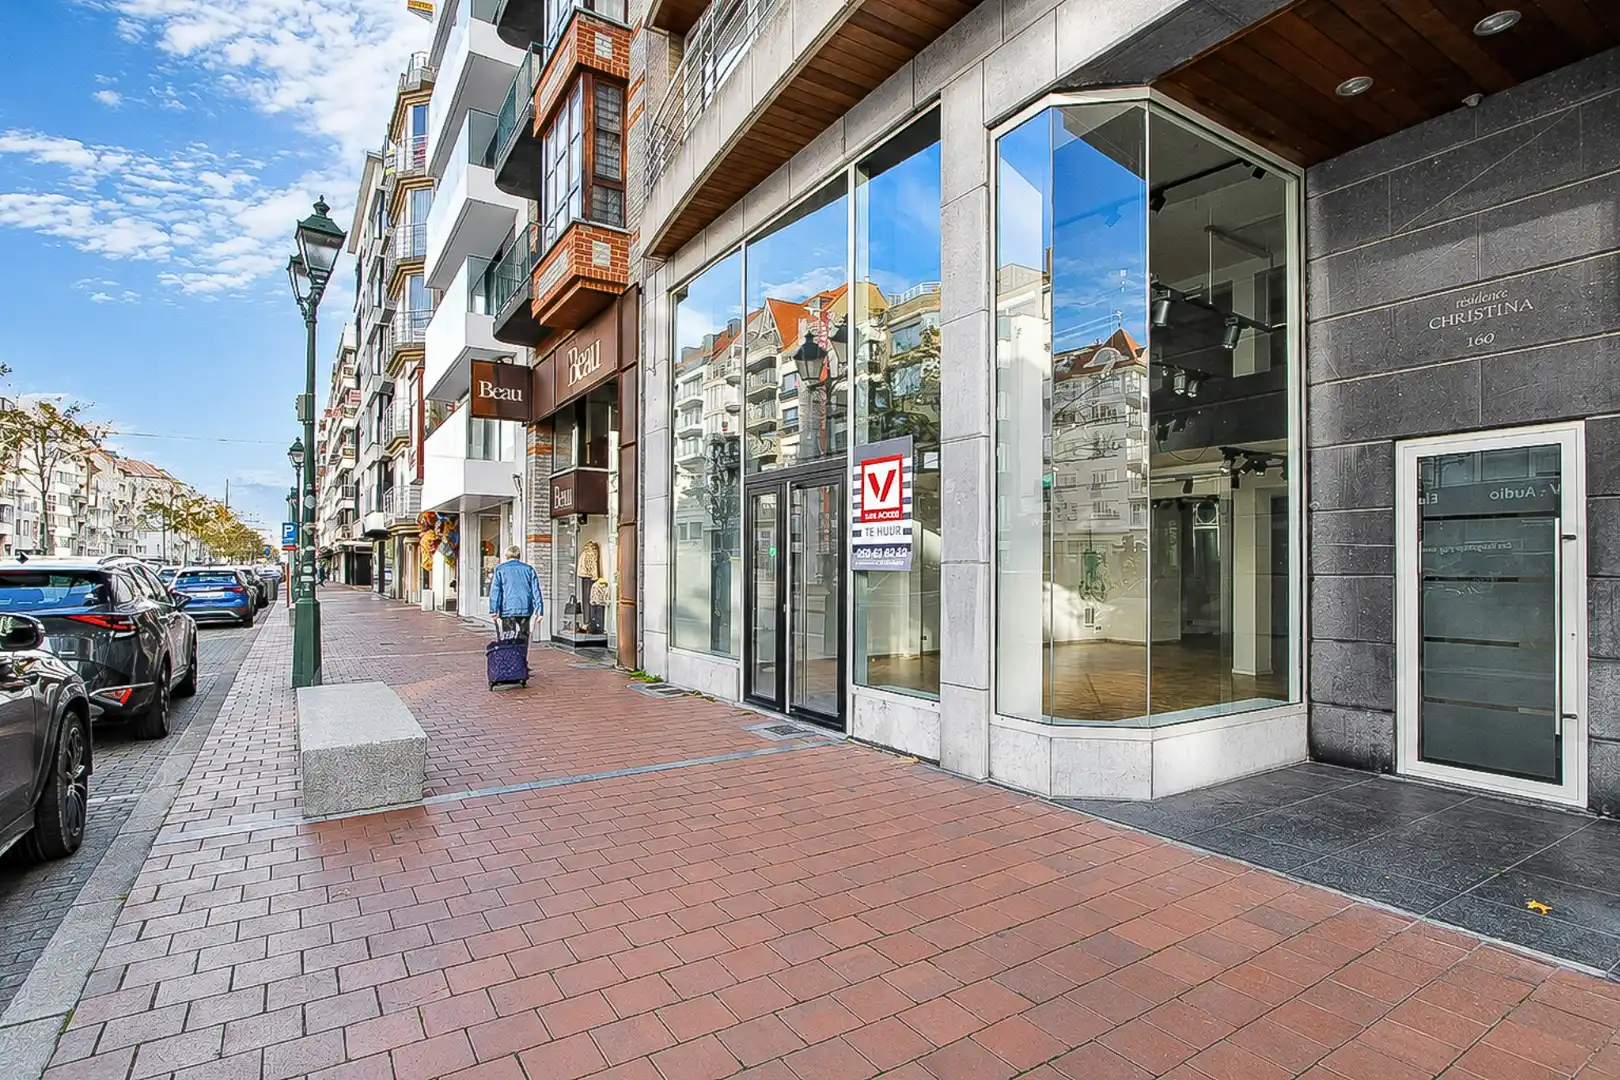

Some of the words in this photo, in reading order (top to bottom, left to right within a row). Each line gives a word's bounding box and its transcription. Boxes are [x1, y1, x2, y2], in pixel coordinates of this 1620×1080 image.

[1428, 299, 1534, 330] CHRISTINA
[1466, 332, 1495, 348] 160
[567, 340, 602, 388] Beau
[478, 380, 523, 402] Beau
[554, 485, 573, 510] Beau
[283, 525, 294, 538] P
[865, 527, 874, 537] TE
[877, 525, 902, 536] HUUR
